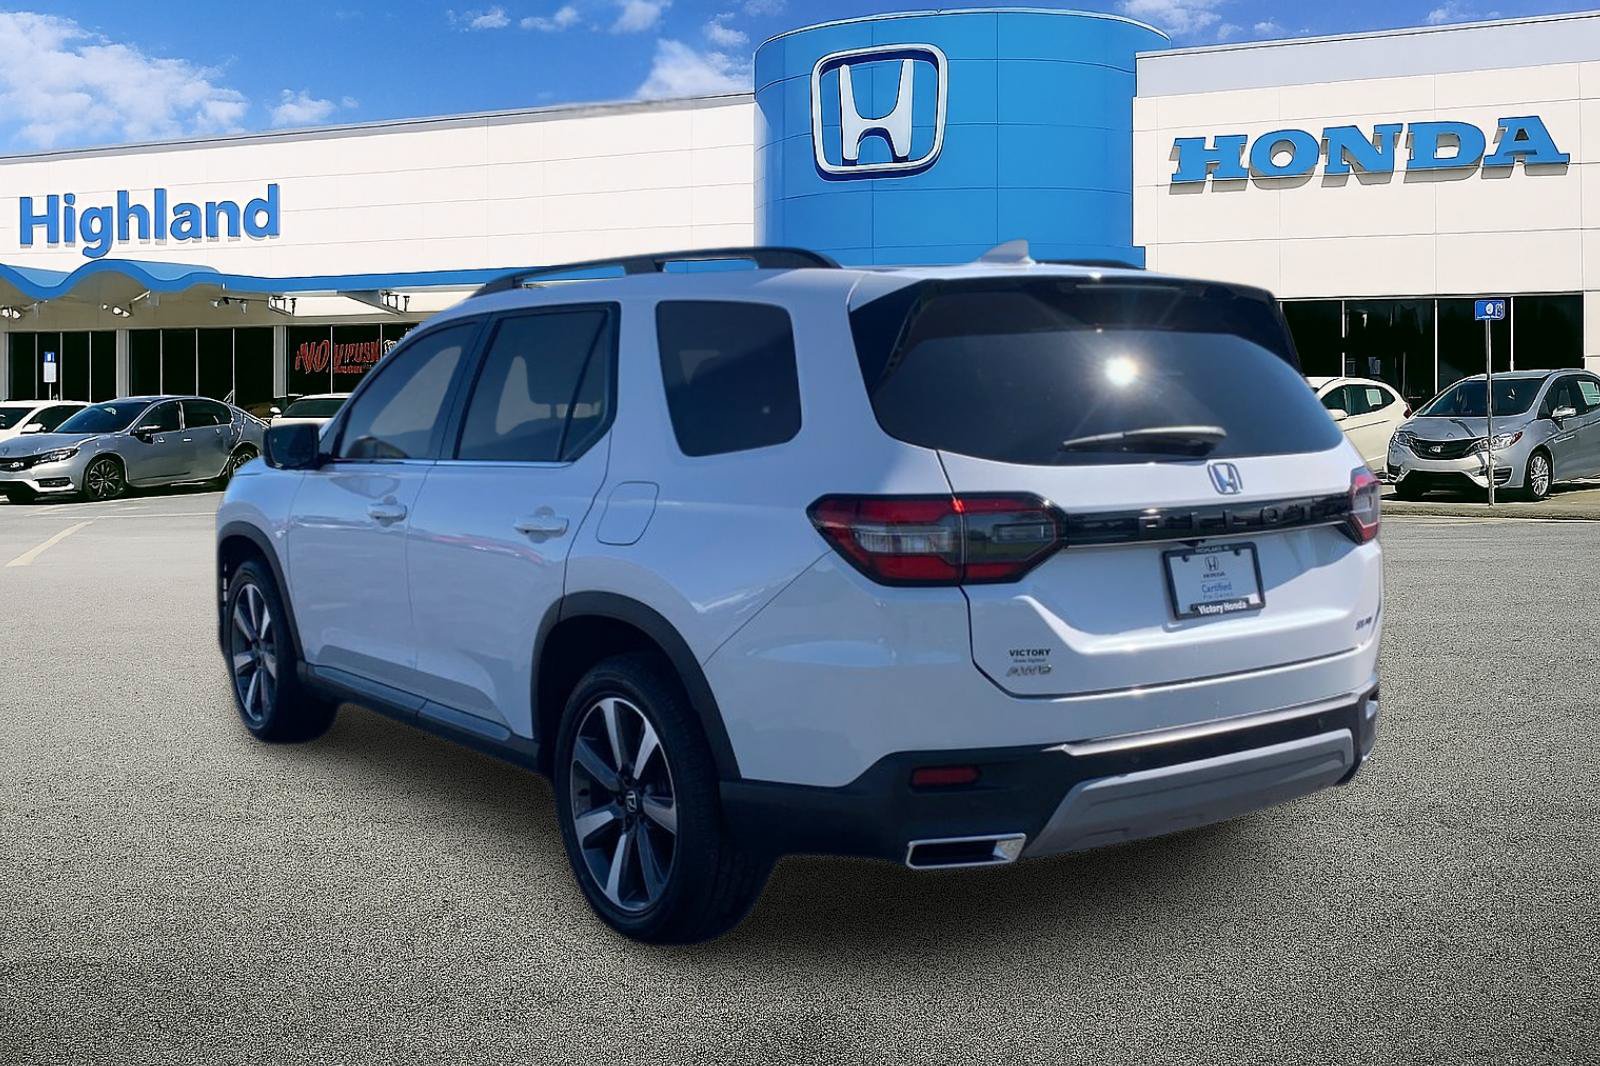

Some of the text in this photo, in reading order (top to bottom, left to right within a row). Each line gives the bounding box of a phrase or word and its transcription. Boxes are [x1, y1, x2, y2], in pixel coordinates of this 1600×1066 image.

[1171, 115, 1570, 186] HONDA
[19, 183, 281, 258] Highland
[1198, 601, 1247, 615] Victory Honda
[1009, 649, 1051, 657] VICTORY
